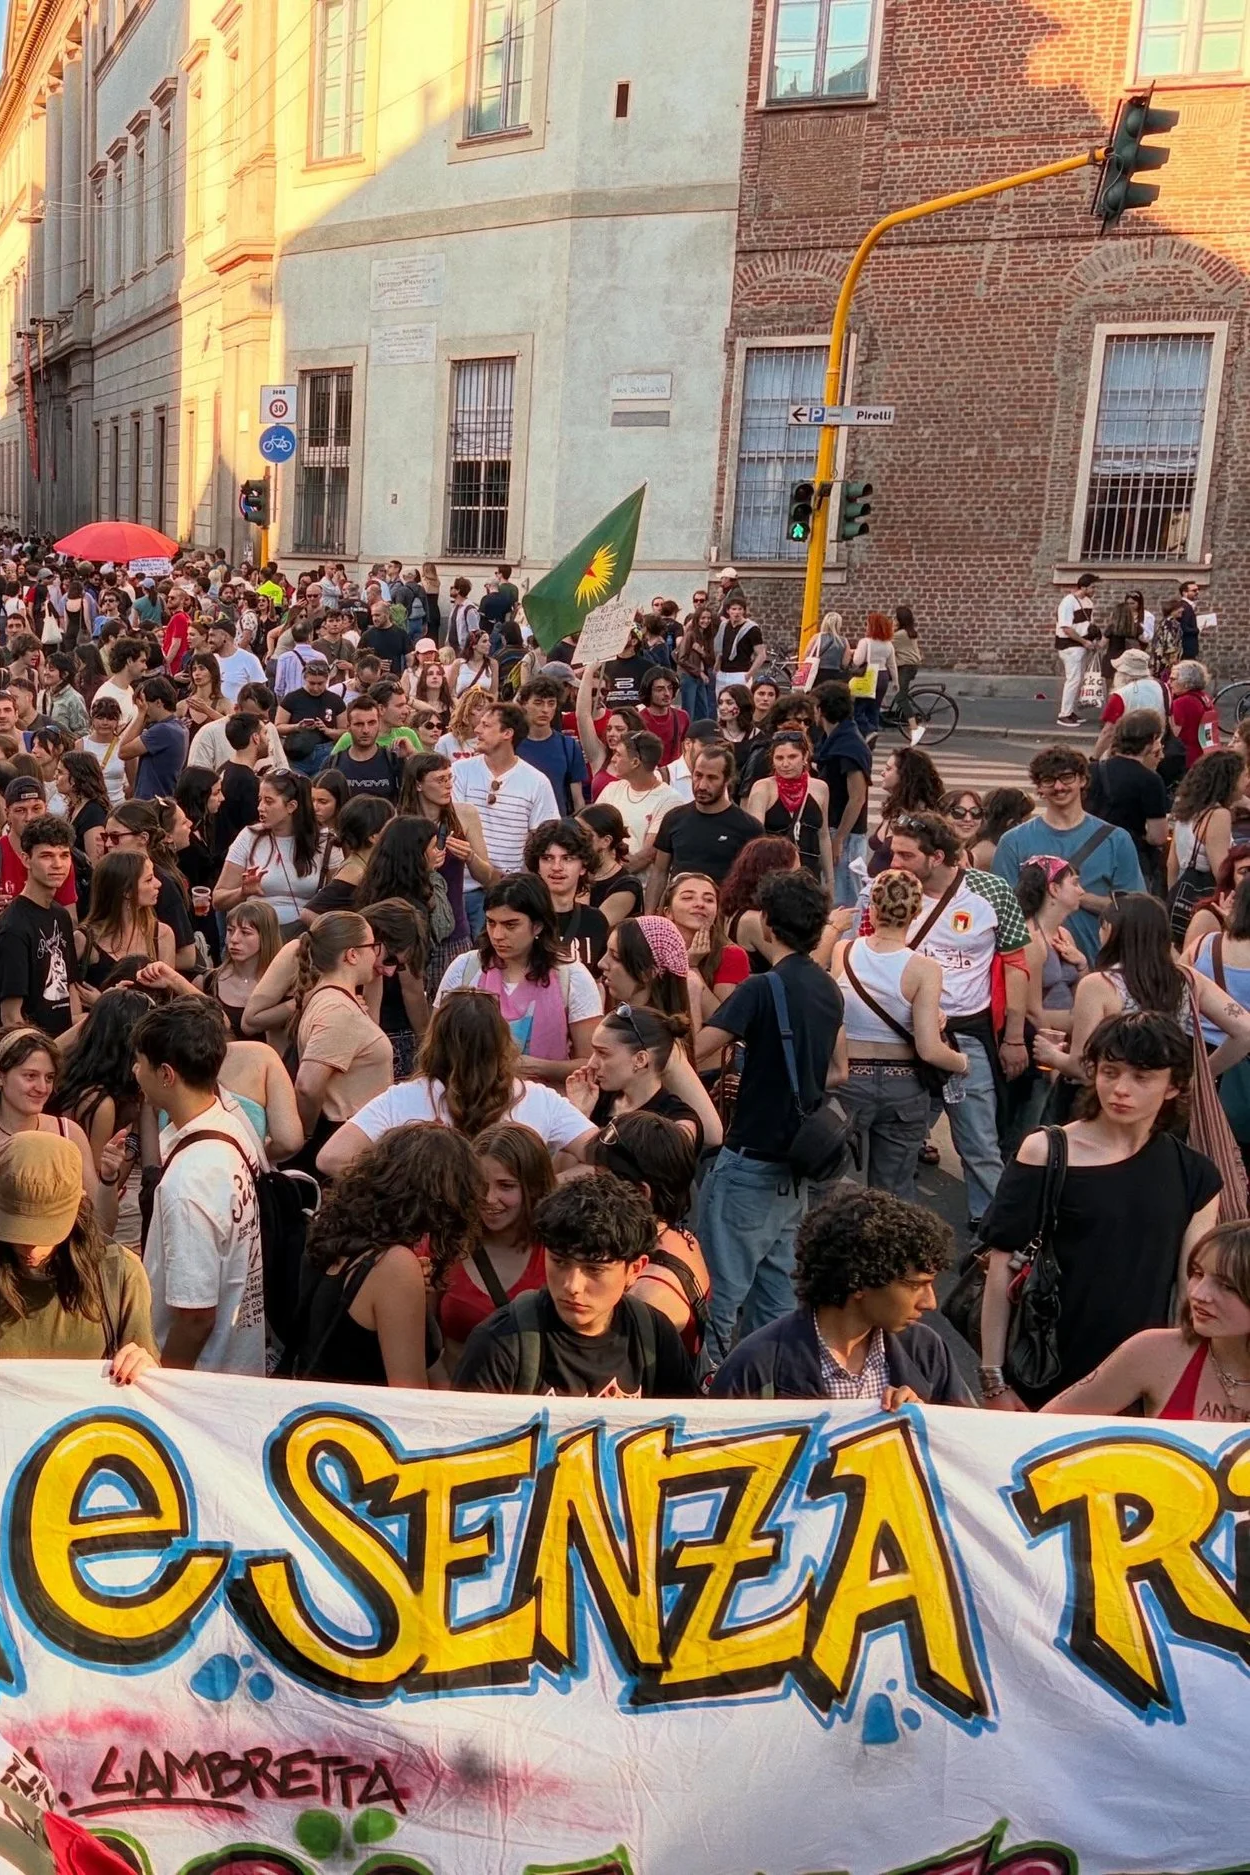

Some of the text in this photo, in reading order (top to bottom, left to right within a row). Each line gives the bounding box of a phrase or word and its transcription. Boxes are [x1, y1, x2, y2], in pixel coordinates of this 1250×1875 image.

[274, 404, 284, 413] 30
[856, 410, 892, 420] Pirelli
[223, 1402, 995, 1724] SENZA
[91, 1745, 408, 1815] LAMBRETTA
